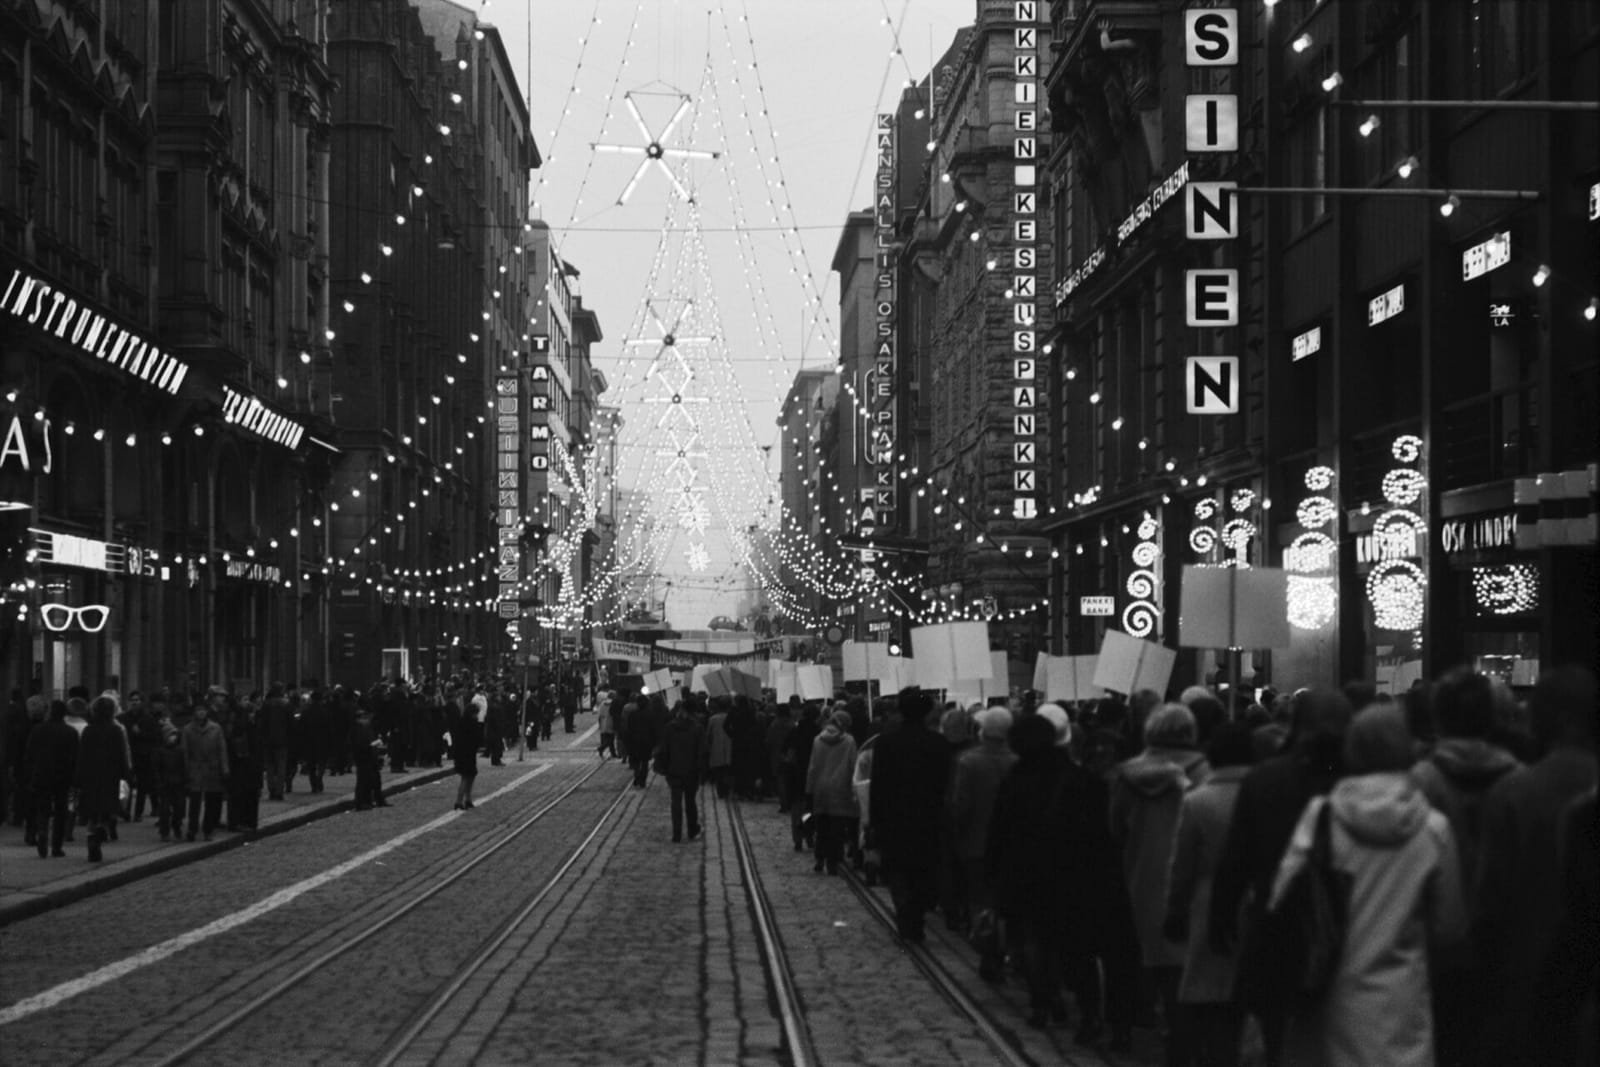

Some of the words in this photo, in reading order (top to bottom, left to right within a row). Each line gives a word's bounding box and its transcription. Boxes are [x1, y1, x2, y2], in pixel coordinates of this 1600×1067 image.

[877, 115, 892, 288] KANSALLIS
[1192, 13, 1232, 409] SINEN
[0, 269, 189, 395] INSTRUMENTARIUM
[877, 302, 892, 397] OSAKE
[1016, 194, 1034, 510] KESKUSPANKKI
[532, 336, 549, 469] TARMO
[877, 411, 892, 525] PANKKI
